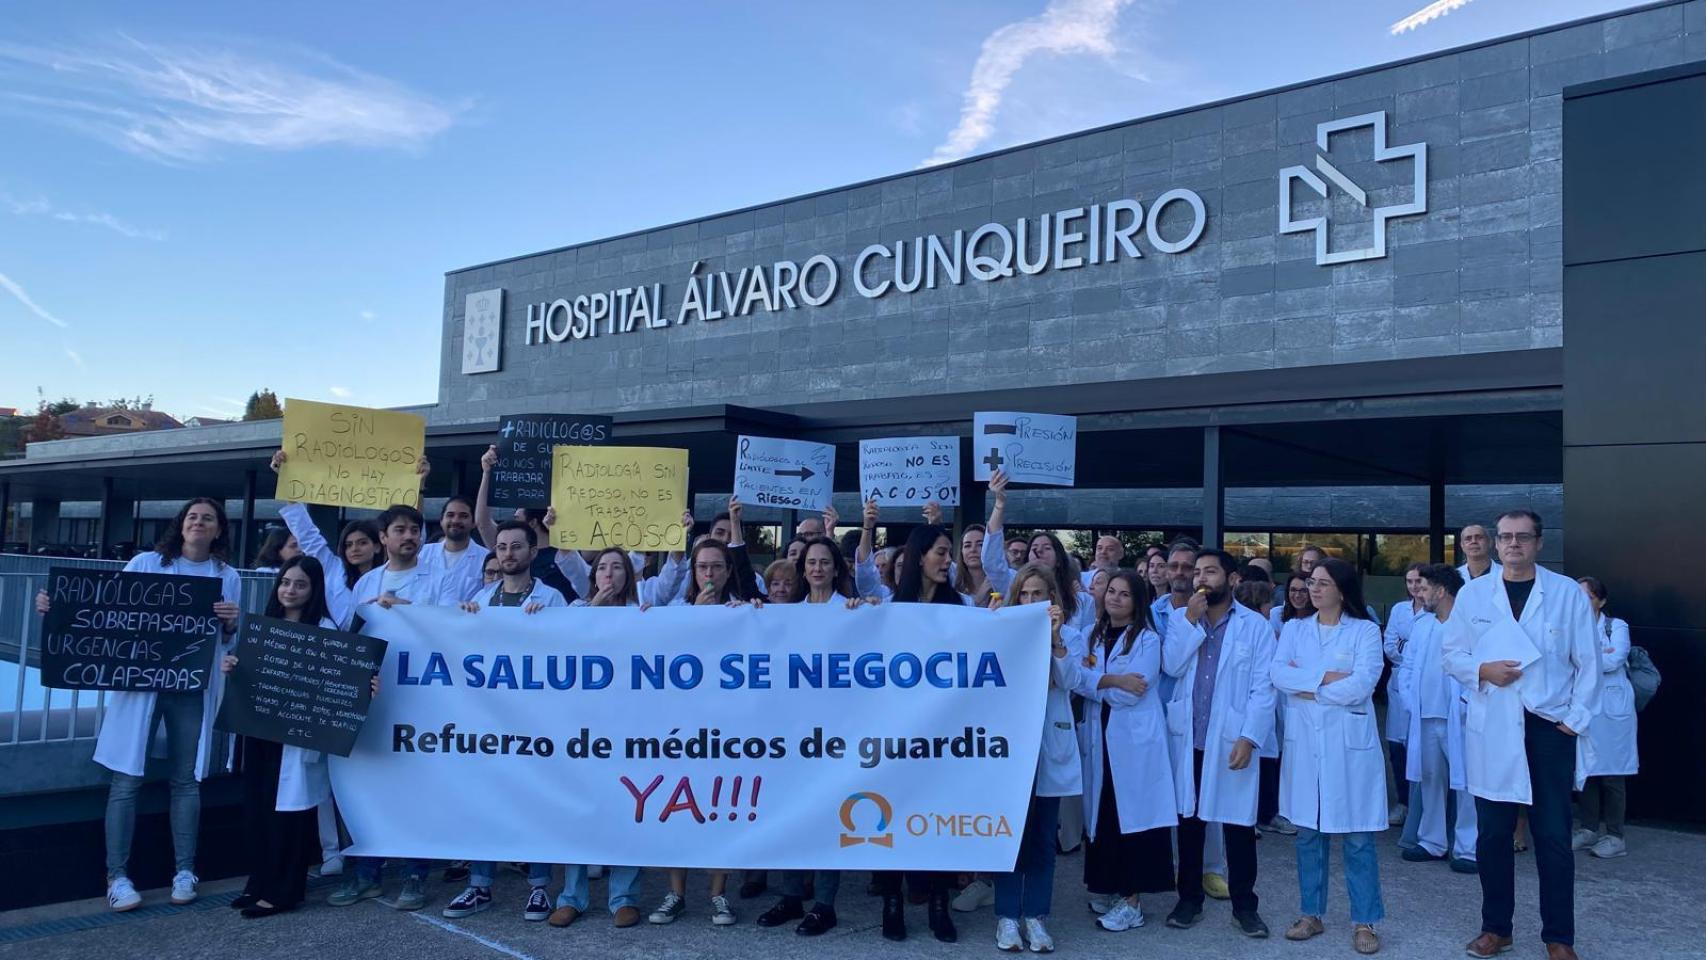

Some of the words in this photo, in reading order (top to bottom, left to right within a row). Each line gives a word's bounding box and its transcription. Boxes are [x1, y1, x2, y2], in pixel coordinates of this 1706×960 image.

[525, 282, 669, 346] HOSPITAL
[677, 254, 839, 325] ÁLVARO
[853, 188, 1207, 299] CUNQUEIRO
[513, 442, 527, 452] DE
[513, 457, 535, 469] NOS
[905, 455, 925, 467] NO
[931, 454, 951, 466] ES
[361, 466, 385, 484] HAY
[494, 470, 545, 485] TRABAJAR
[495, 488, 510, 499] ES
[517, 488, 545, 498] PARA
[630, 488, 648, 499] NO
[658, 489, 673, 501] ES
[560, 530, 578, 543] ES
[71, 609, 218, 636] SOBREPASADAS
[47, 633, 164, 661] URGENCIAS
[63, 663, 204, 690] COLAPSADAS
[397, 652, 453, 687] LA
[463, 654, 614, 691] SALUD
[631, 654, 704, 690] NO
[720, 653, 772, 689] SE
[788, 652, 1007, 689] NEGOCIA
[392, 723, 554, 757] Refuerzo
[566, 728, 613, 759] de
[625, 728, 786, 759] médicos
[800, 728, 846, 759] de
[858, 727, 1010, 769] guardia
[620, 774, 762, 824] YA!!!
